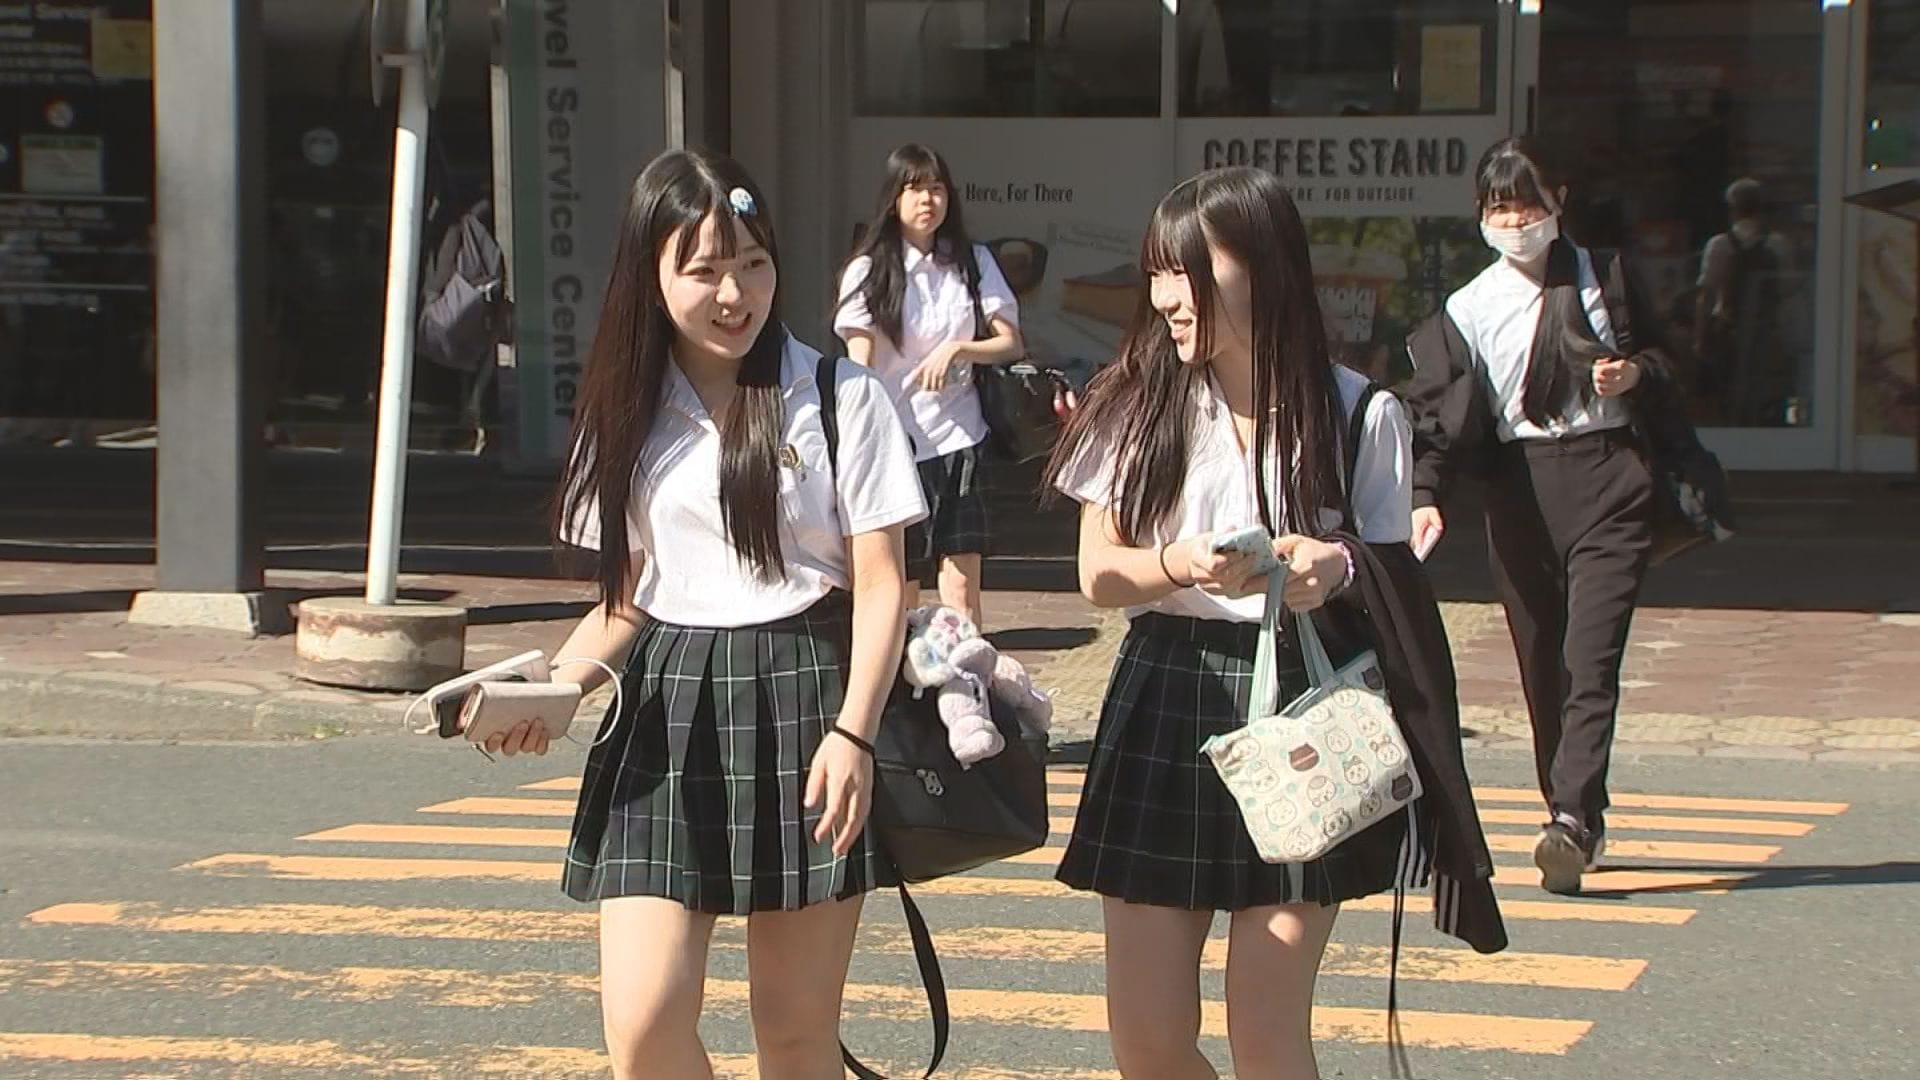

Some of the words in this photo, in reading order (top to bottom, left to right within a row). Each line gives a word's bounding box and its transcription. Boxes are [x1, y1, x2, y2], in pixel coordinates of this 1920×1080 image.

[544, 0, 578, 69] vel
[546, 86, 580, 258] Service
[1203, 138, 1338, 178] COFFEE
[1348, 137, 1466, 178] STAND
[965, 182, 1003, 203] Here,
[1007, 183, 1029, 202] For
[1034, 183, 1074, 202] There
[1325, 187, 1351, 202] FOR
[551, 274, 583, 416] Center
